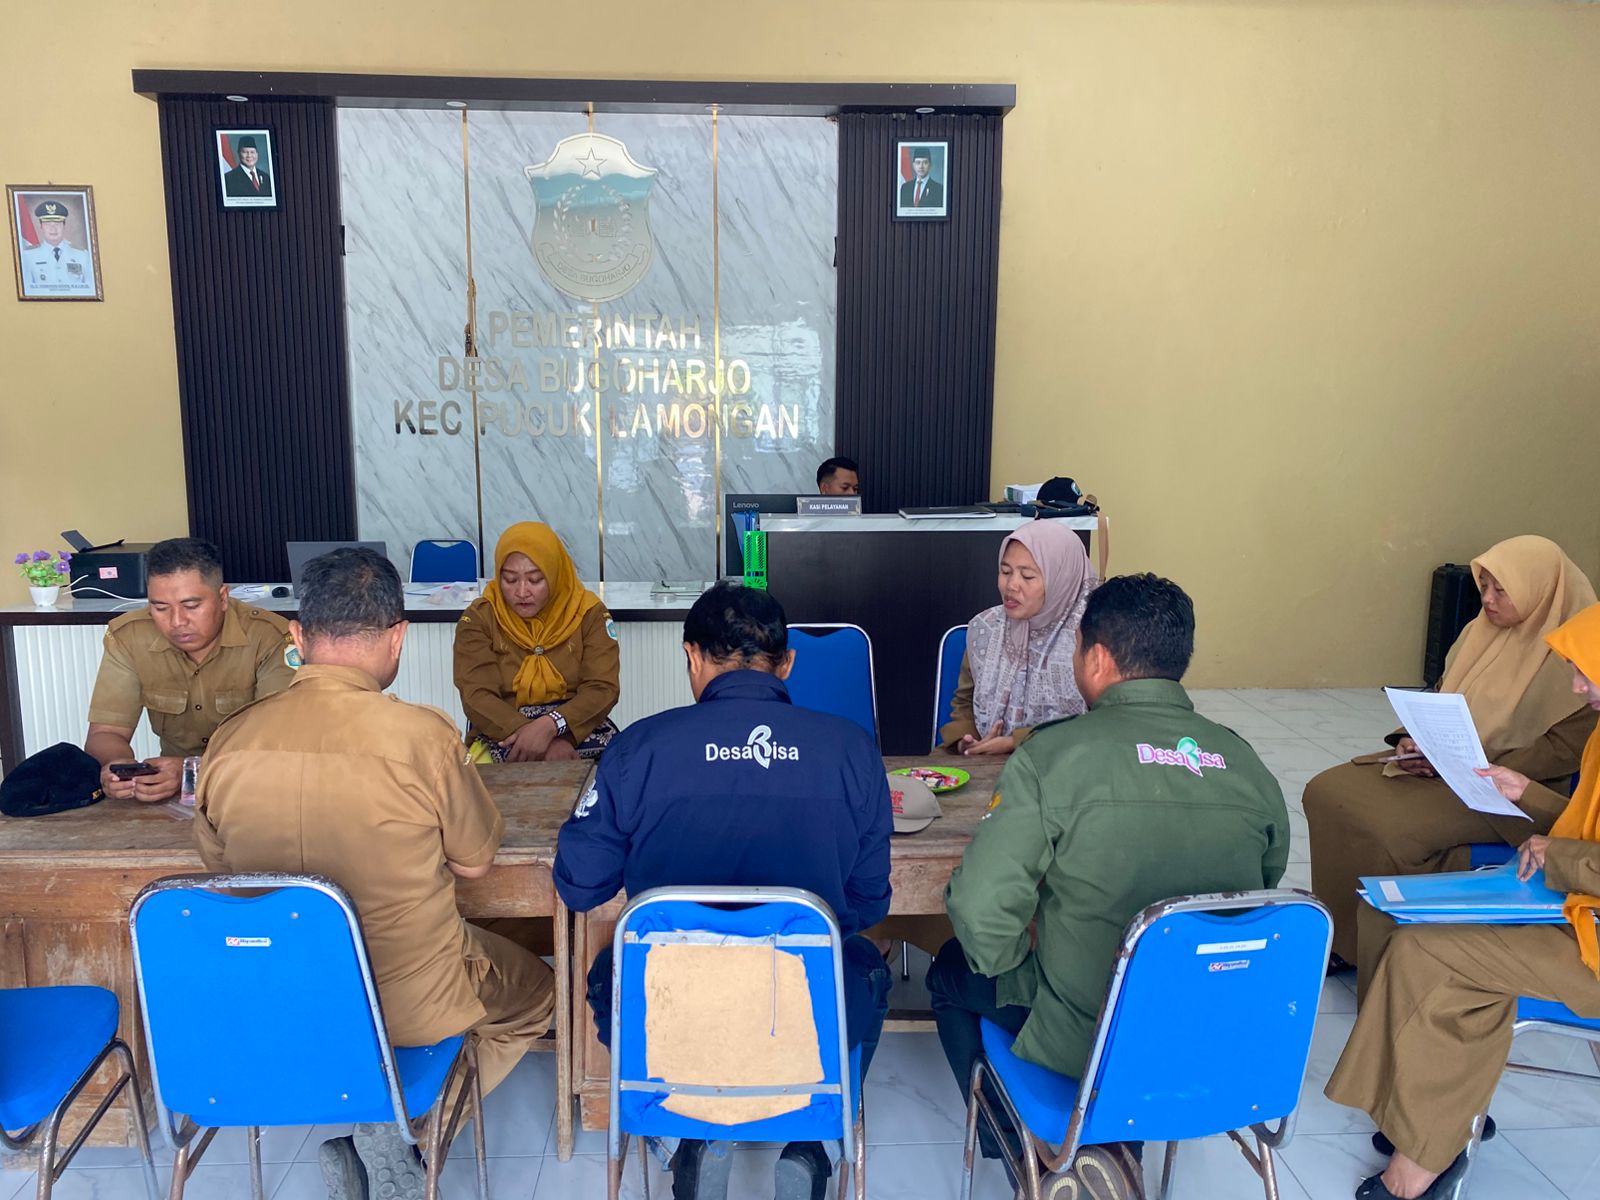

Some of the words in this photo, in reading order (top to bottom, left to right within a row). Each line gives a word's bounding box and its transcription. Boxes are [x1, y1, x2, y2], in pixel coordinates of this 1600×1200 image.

[488, 311, 701, 350] PEMERINTAH
[438, 356, 529, 393] DESA
[539, 357, 751, 396] BUGOHARJO
[393, 399, 463, 436] KEC
[478, 400, 592, 438] PUCUK
[608, 402, 800, 440] LAMONGAN
[732, 501, 760, 509] Lenovo
